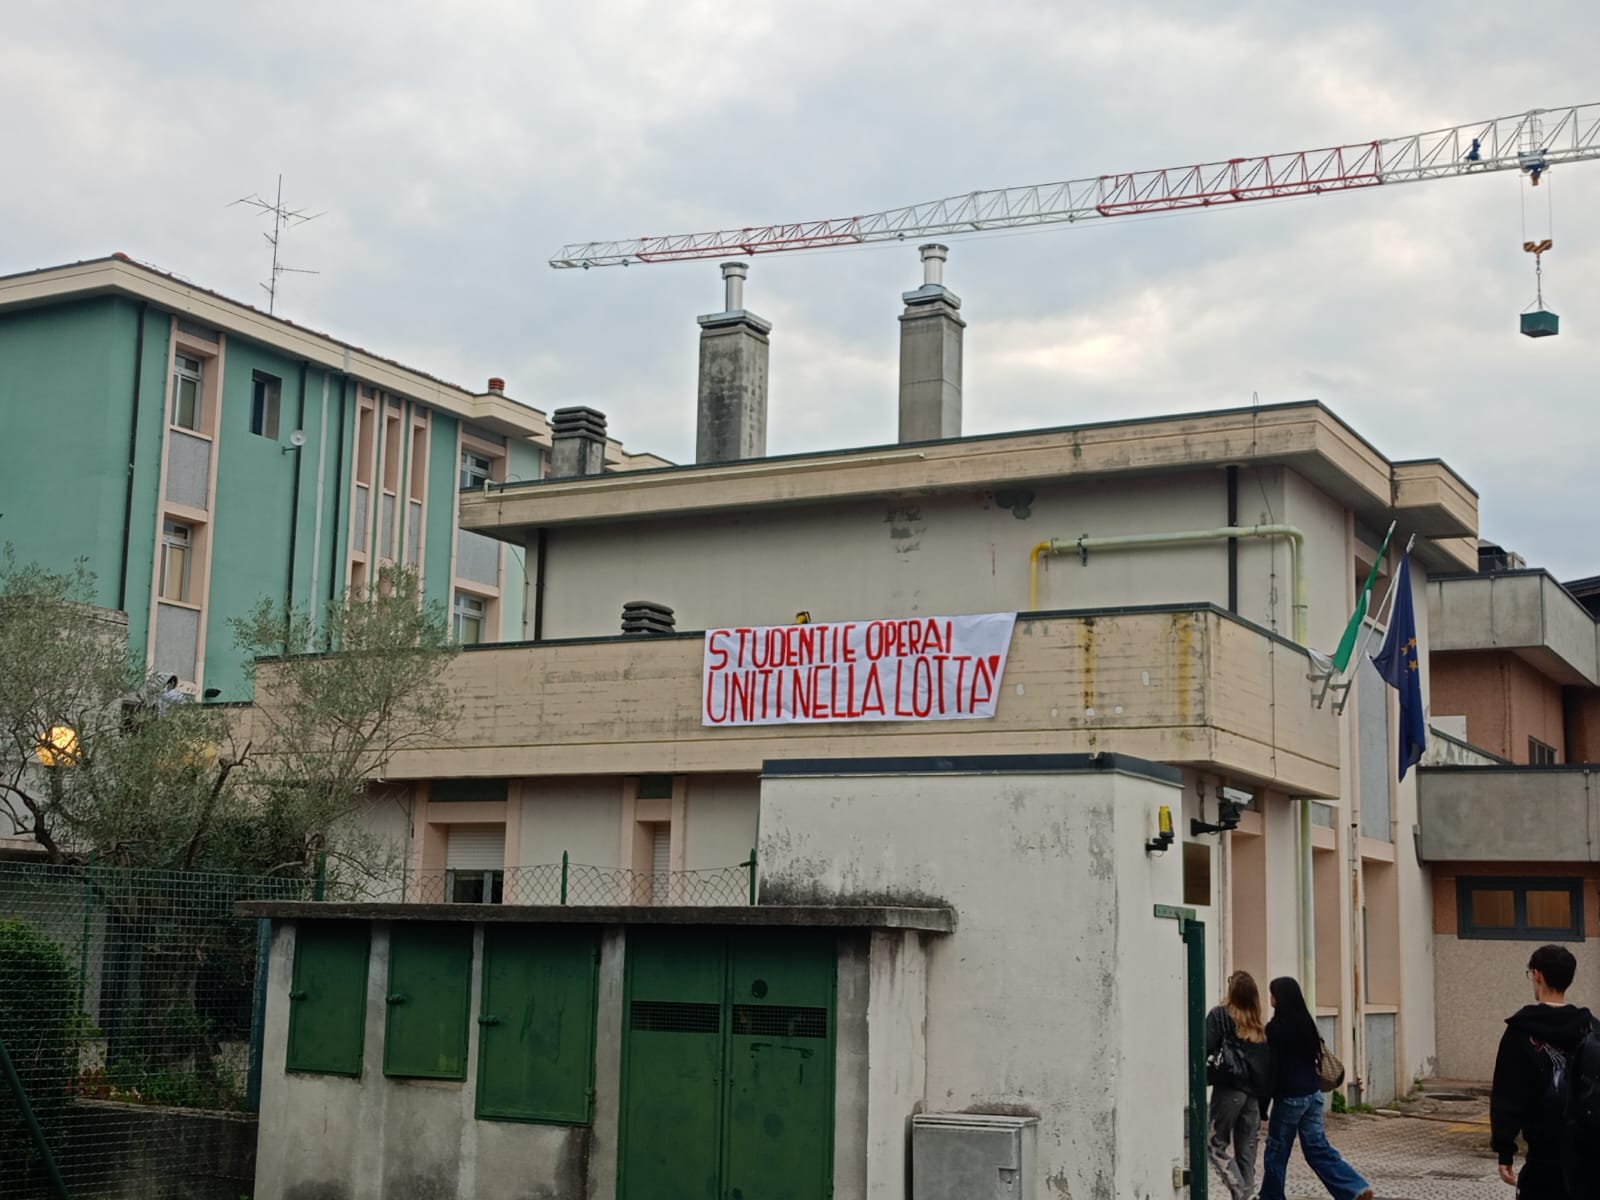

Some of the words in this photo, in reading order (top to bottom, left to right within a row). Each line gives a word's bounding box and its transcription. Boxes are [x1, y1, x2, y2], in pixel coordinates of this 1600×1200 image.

[866, 618, 952, 661] OPERAI
[706, 669, 783, 723] UNITI
[792, 663, 885, 719] NELLA
